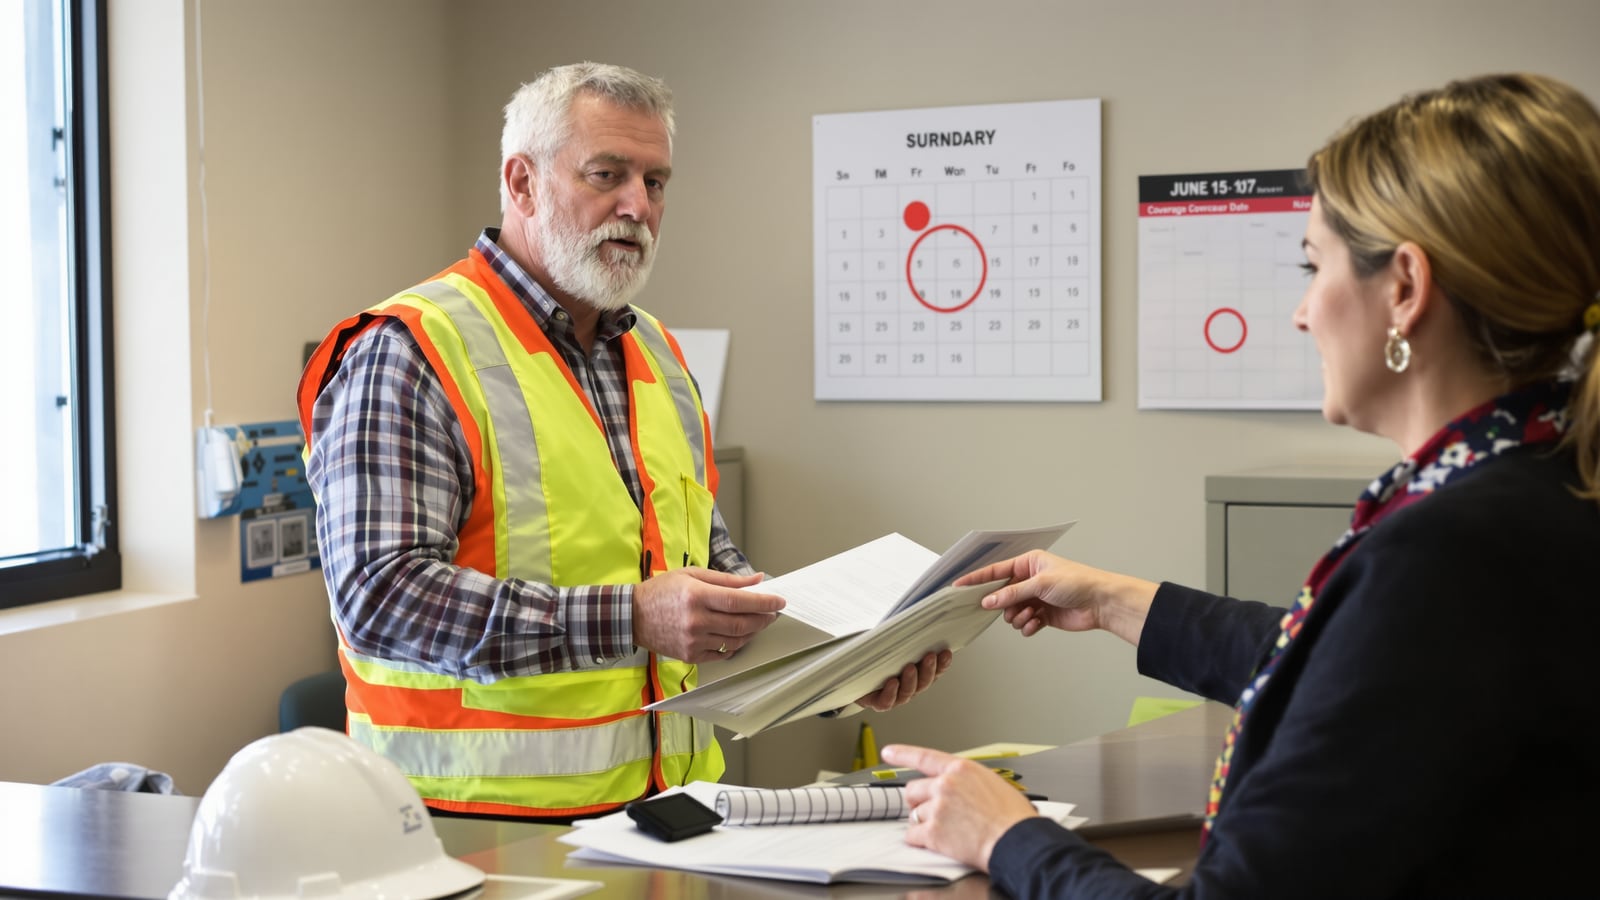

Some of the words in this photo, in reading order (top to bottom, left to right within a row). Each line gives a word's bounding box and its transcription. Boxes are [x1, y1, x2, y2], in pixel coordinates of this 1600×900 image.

[906, 129, 997, 149] SURNDARY
[986, 165, 998, 174] Tu
[1170, 181, 1208, 196] JUNE
[1029, 256, 1039, 266] 17
